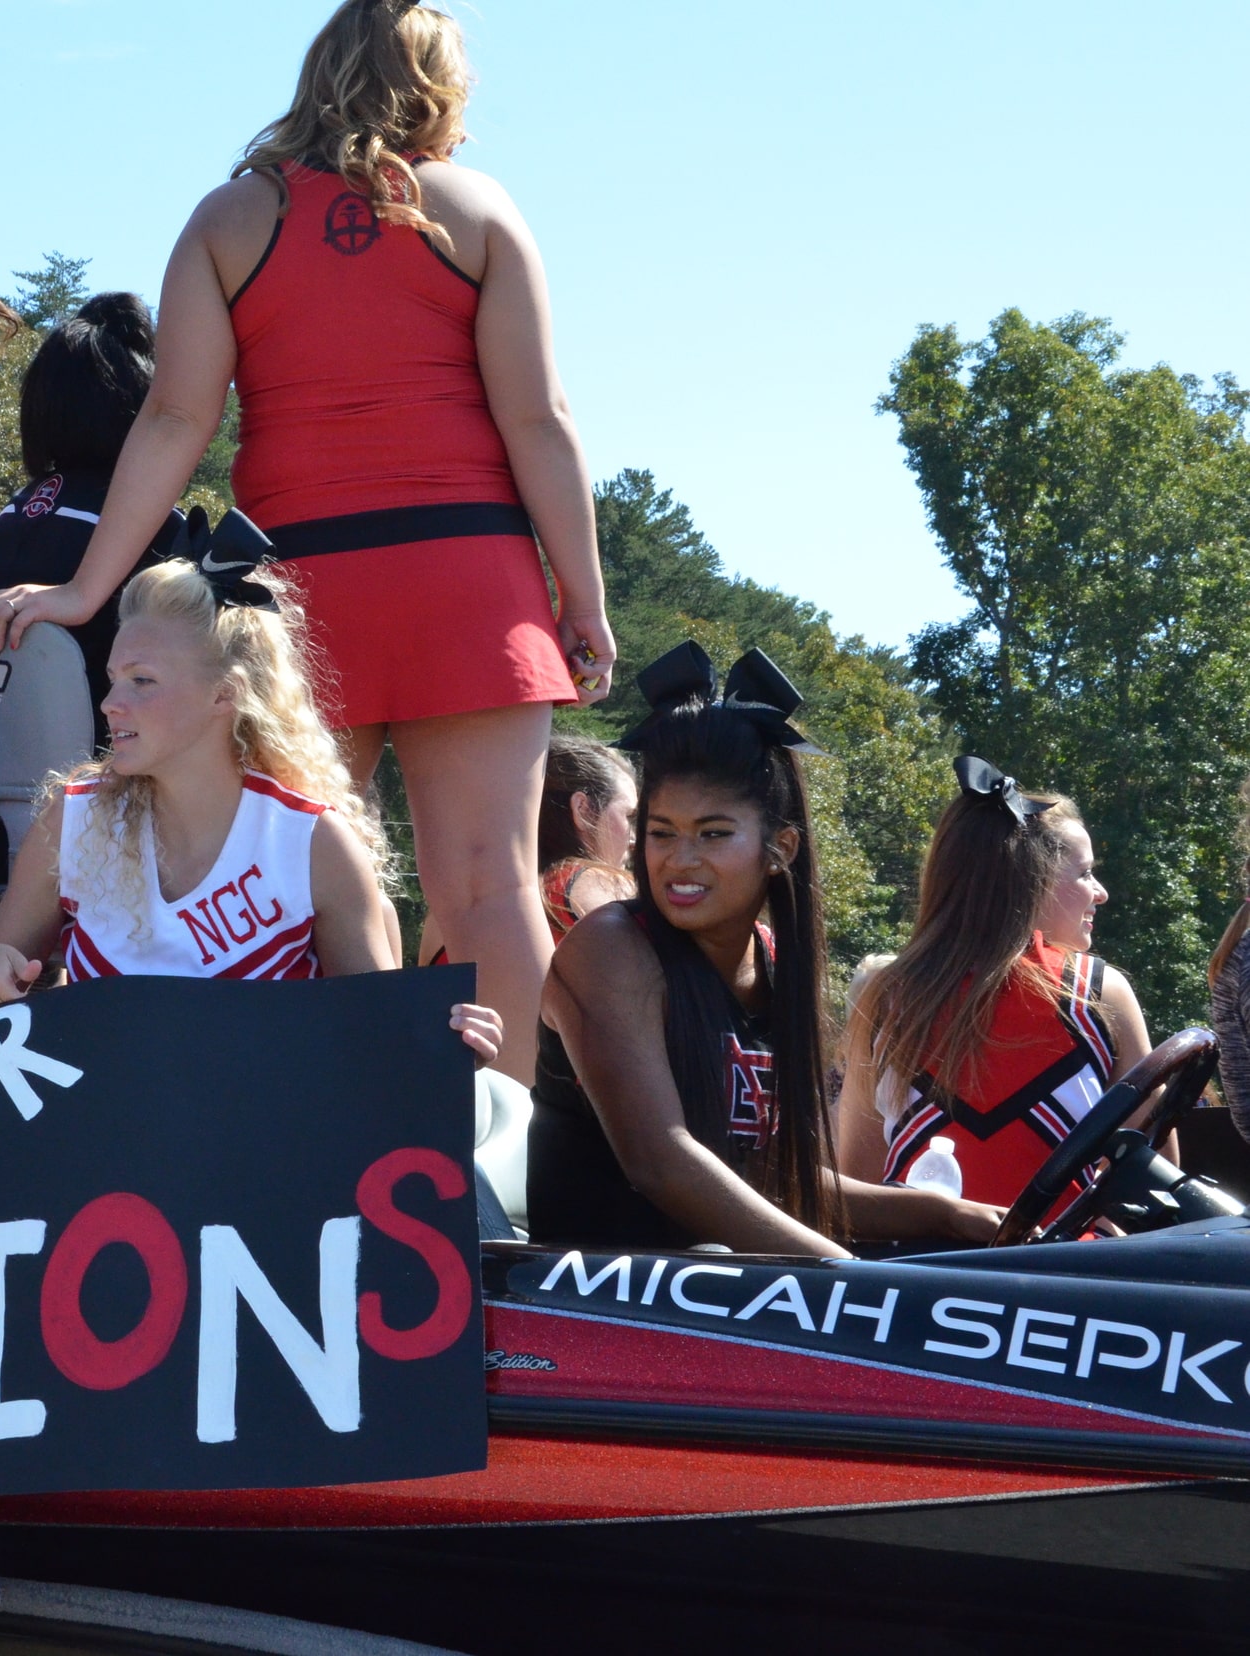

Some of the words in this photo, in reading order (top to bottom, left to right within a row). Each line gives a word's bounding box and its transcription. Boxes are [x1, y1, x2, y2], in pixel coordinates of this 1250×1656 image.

[176, 863, 284, 966] NGC
[485, 1350, 557, 1371] Edition
[539, 1250, 899, 1343] MICAH
[923, 1297, 1250, 1405] SEPK
